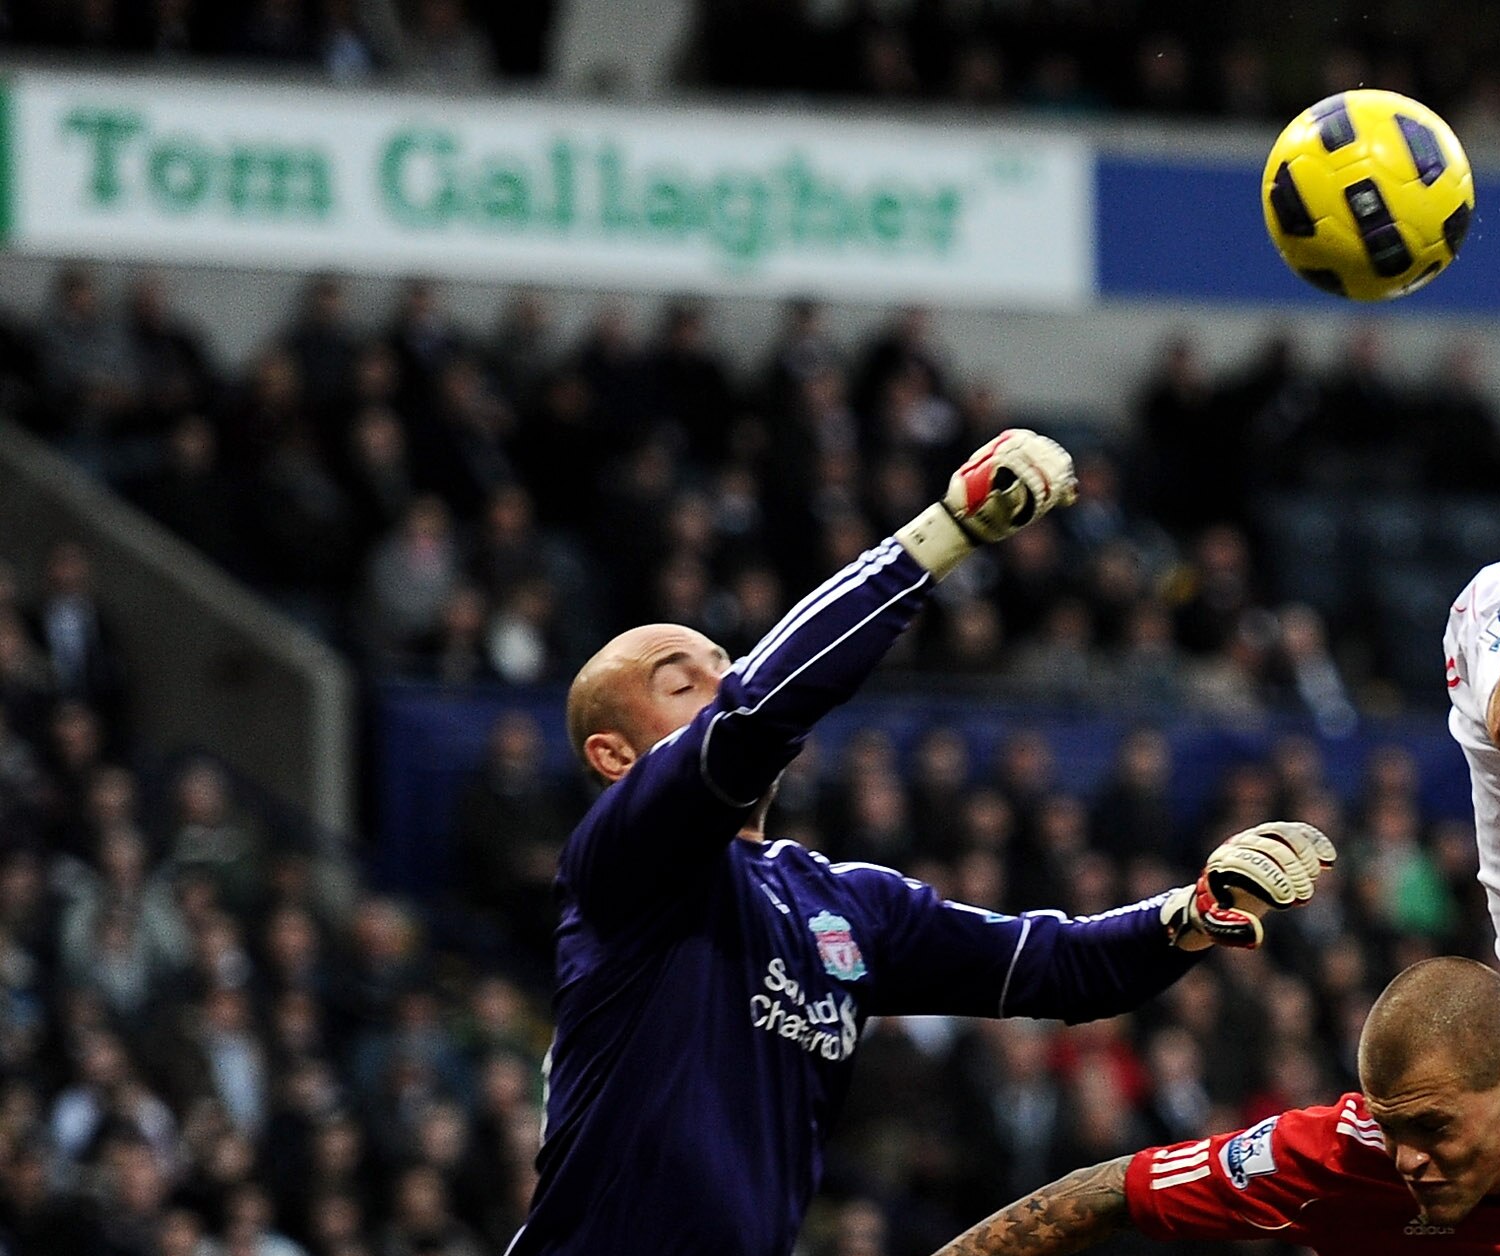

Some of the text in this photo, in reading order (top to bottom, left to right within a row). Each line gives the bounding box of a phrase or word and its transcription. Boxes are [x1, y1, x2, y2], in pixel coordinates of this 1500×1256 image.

[64, 104, 962, 281] Tom Gallagher
[1234, 850, 1292, 894] uhlspor
